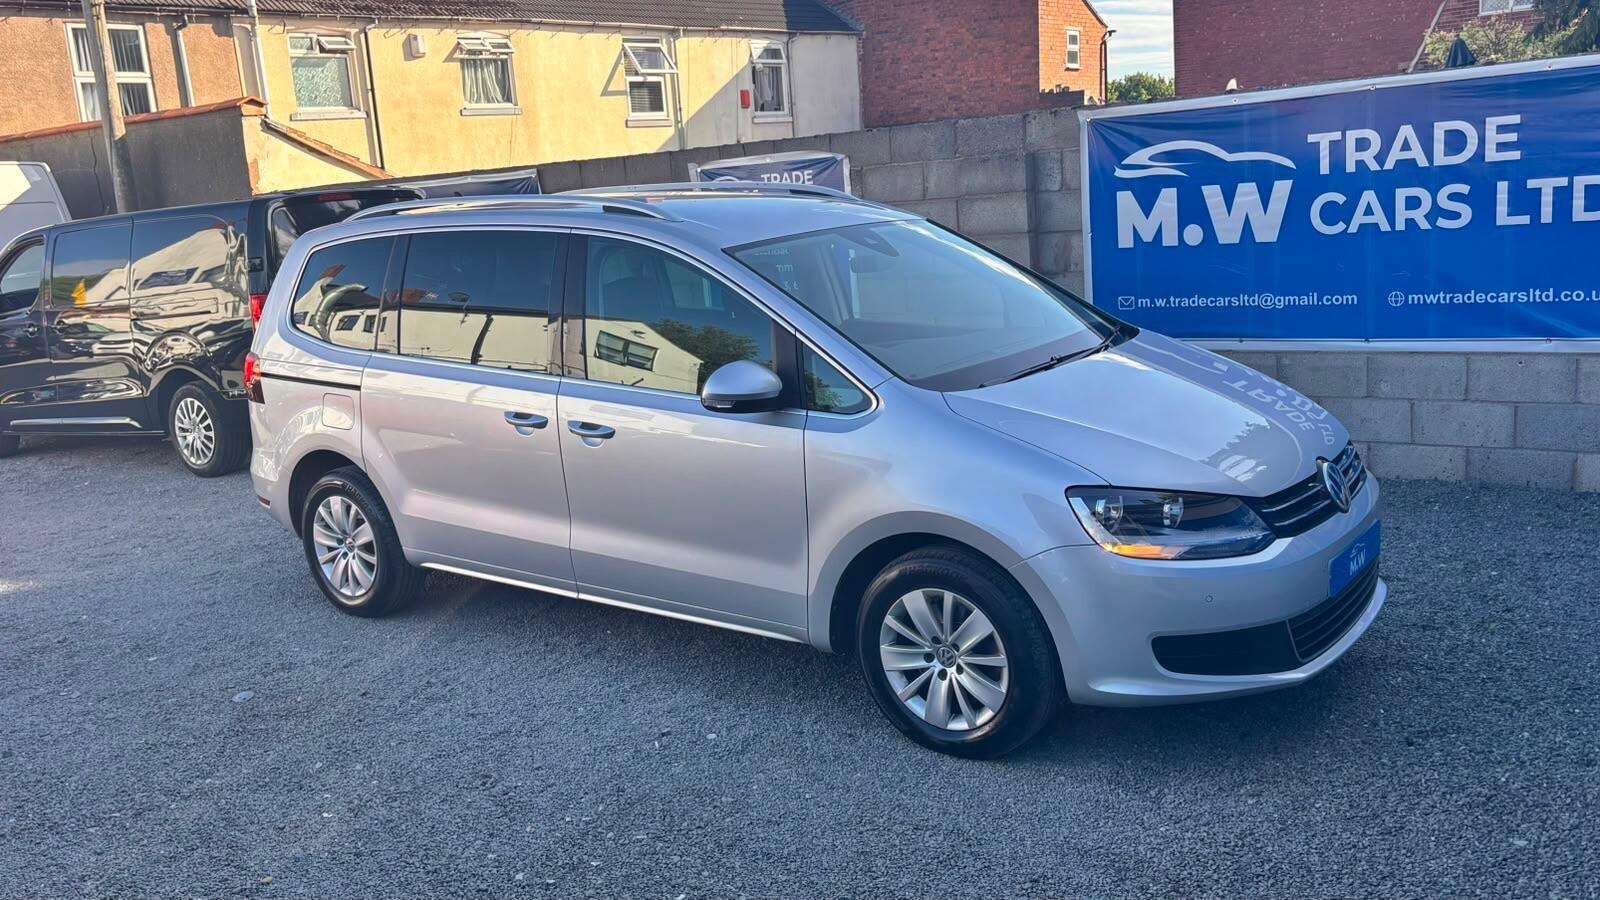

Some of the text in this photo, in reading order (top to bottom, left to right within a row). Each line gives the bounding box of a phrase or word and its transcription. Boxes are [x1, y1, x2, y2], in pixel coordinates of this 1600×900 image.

[1307, 114, 1521, 175] TRADE
[760, 170, 814, 184] TRADE
[1310, 175, 1600, 235] CARS LTD
[1116, 179, 1294, 249] M.W
[1137, 291, 1358, 311] m.w.tradecarsltd@gmail.com
